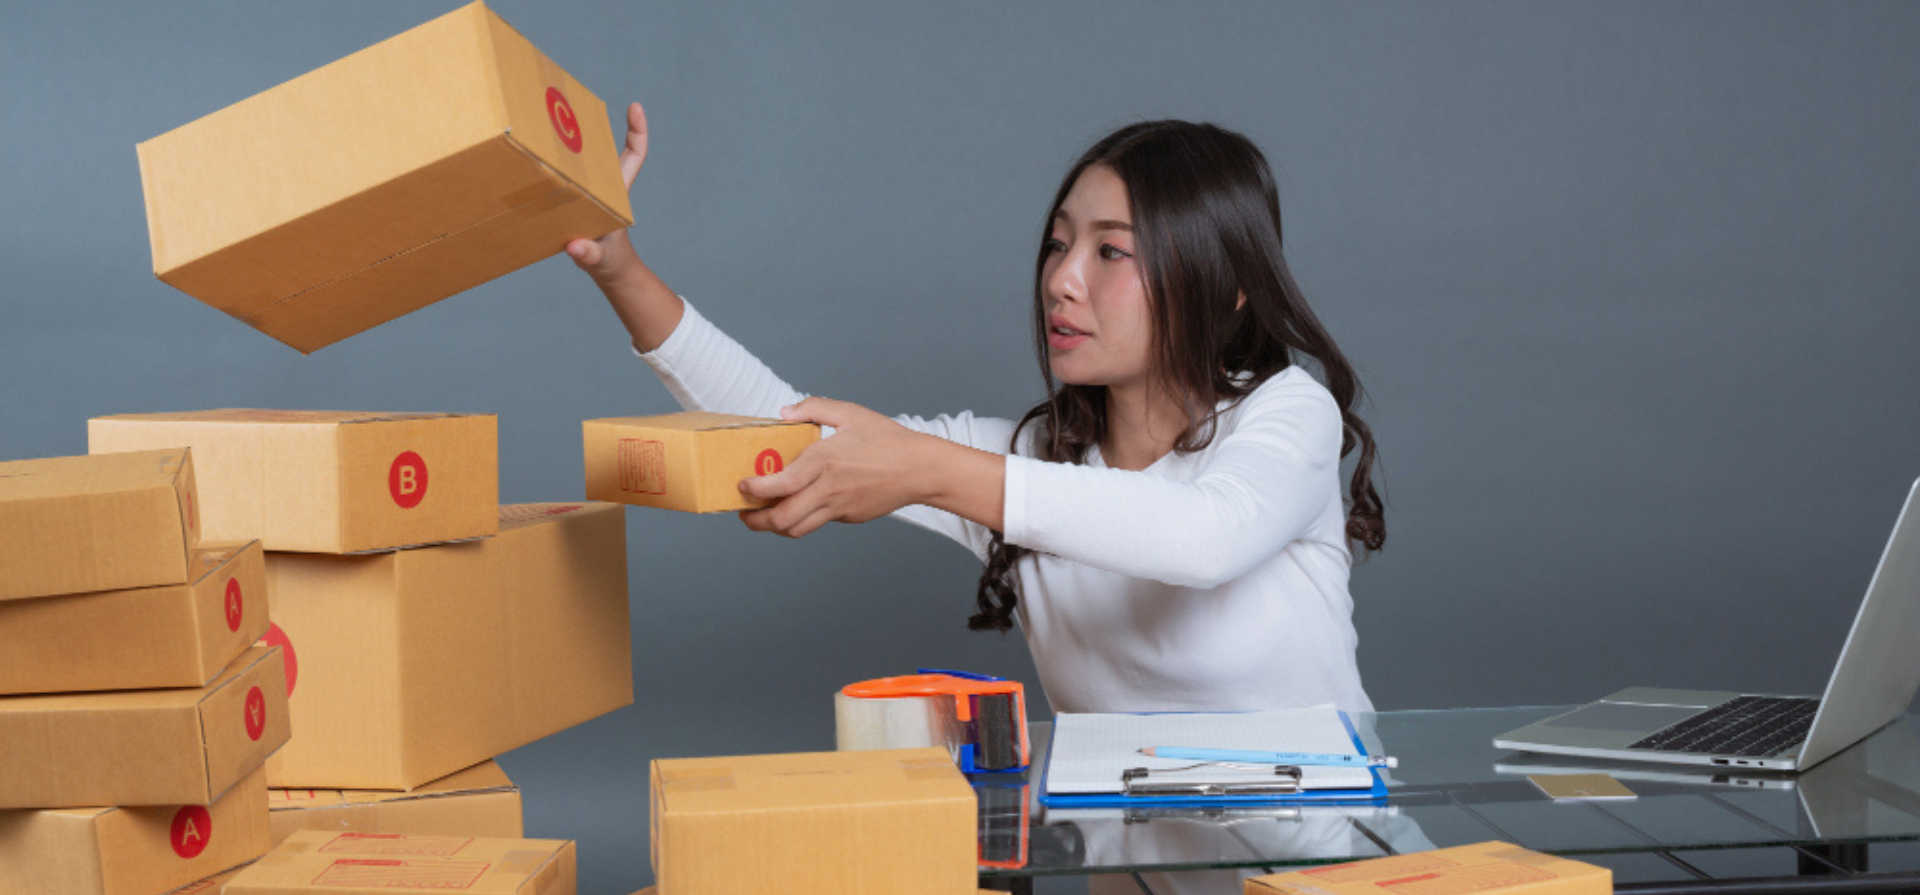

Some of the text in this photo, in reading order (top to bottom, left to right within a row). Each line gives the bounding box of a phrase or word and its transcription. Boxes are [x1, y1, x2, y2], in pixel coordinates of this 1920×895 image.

[554, 100, 575, 139] C
[400, 465, 417, 495] B
[230, 593, 239, 619] A
[249, 699, 260, 727] A
[182, 817, 201, 846] A
